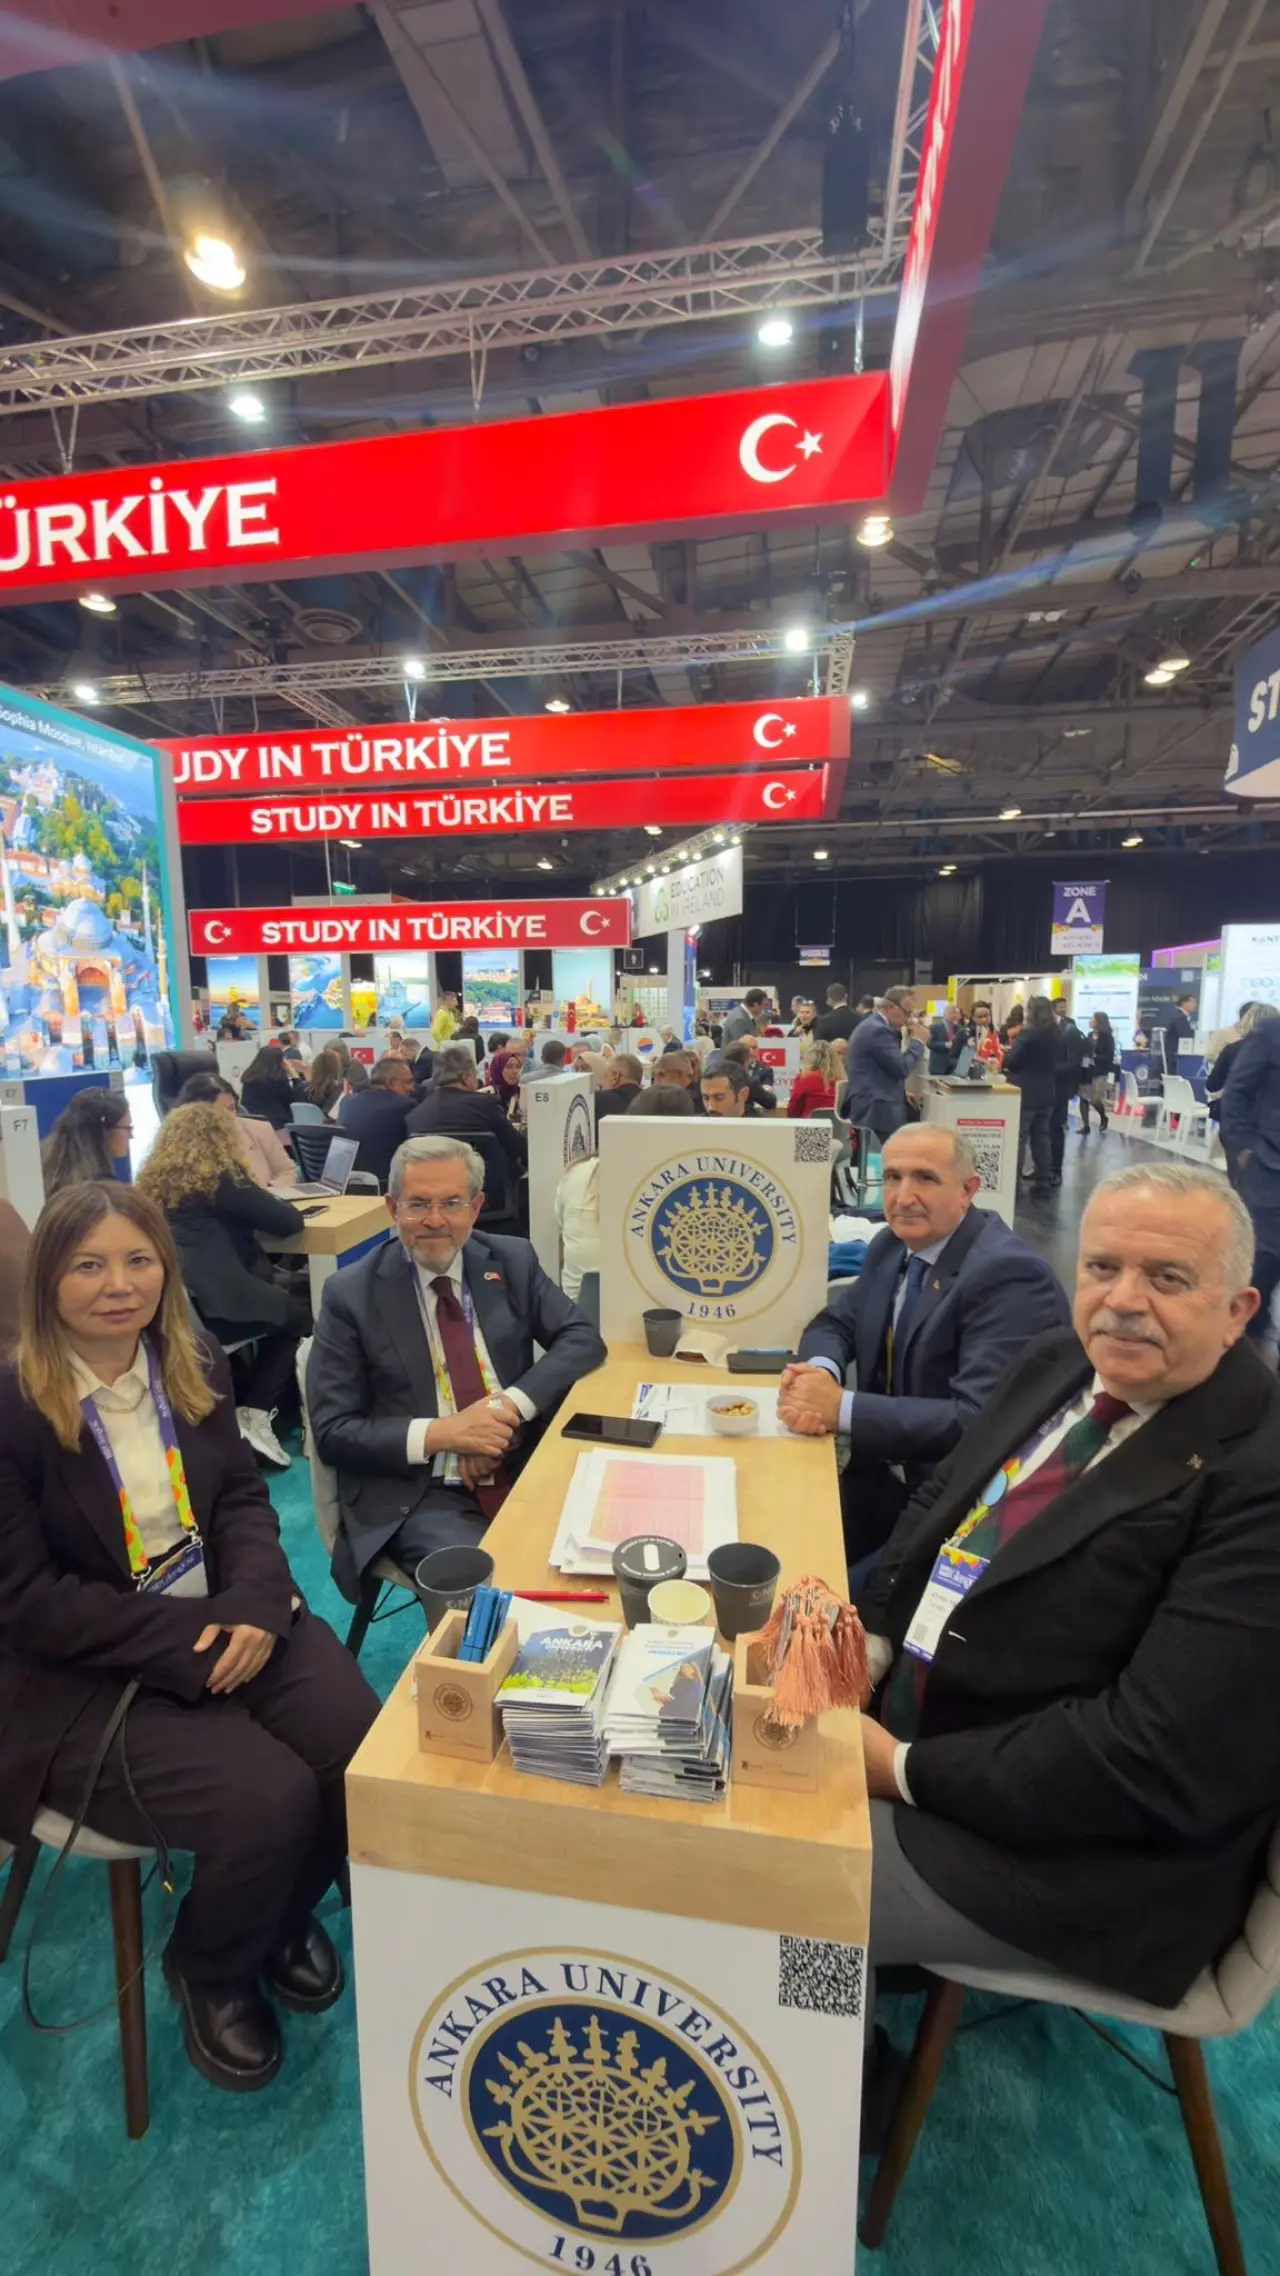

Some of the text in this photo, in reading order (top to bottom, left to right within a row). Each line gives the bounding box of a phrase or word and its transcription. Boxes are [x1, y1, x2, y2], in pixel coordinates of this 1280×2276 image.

[0, 705, 37, 731] ophia
[258, 744, 303, 779] IN
[311, 728, 512, 776] TÜRKİYE
[251, 791, 574, 834] STUDY IN TÜRKİYE
[671, 865, 724, 899] EDUCATION
[1063, 886, 1097, 898] ZONE
[261, 911, 548, 945] STUDY IN TÜRKİYE
[1065, 898, 1092, 924] A
[629, 1156, 797, 1245] ANKARA UNIVERSITY
[687, 1301, 736, 1319] 1946
[424, 1963, 784, 2168] ANKARA UNIVERSITY
[548, 2234, 652, 2276] 1946
